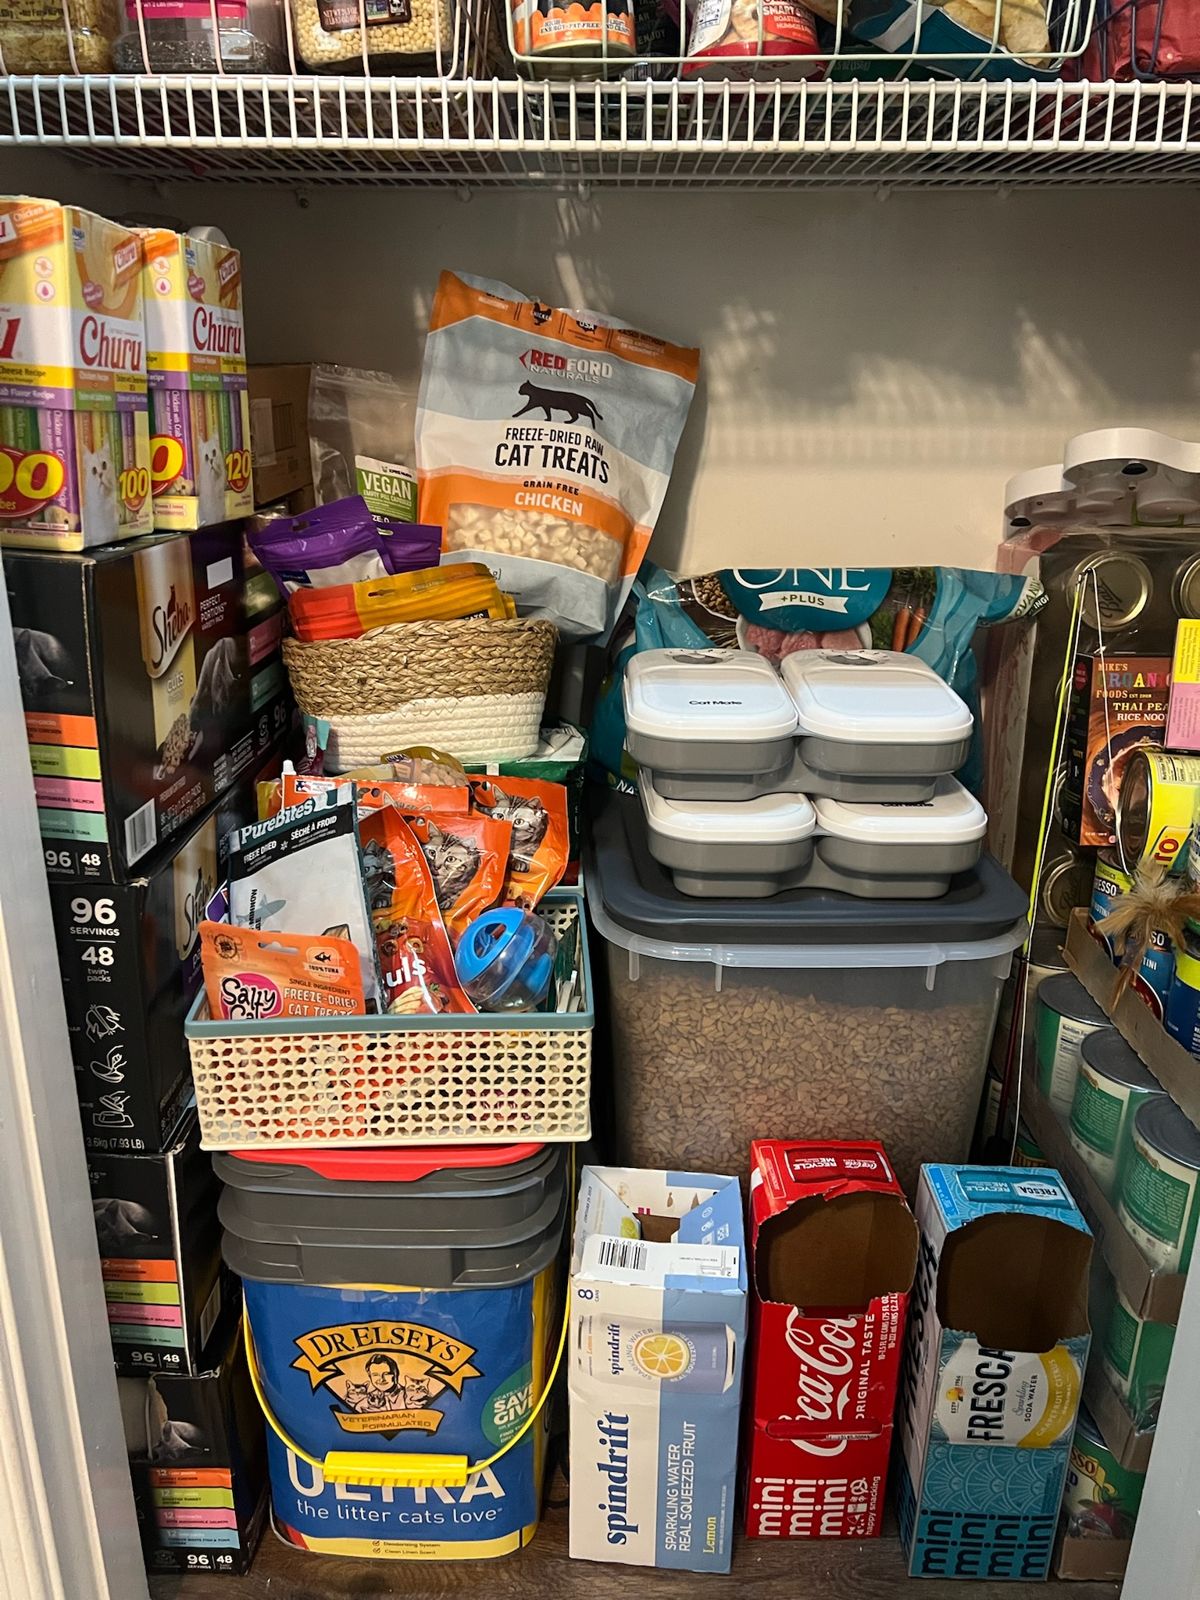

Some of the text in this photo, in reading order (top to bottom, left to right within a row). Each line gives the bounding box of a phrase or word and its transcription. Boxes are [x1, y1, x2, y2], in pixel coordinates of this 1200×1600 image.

[79, 315, 142, 372] Churu
[193, 306, 242, 354] Churu
[529, 365, 600, 384] NATURALS
[506, 427, 605, 456] FREEZE-DRIED RAW
[225, 449, 250, 481] 120
[495, 442, 610, 485] CAT TREATS
[119, 468, 148, 500] 100
[361, 471, 412, 501] VEGAN
[523, 480, 580, 496] GRAIN FREE
[514, 491, 584, 518] CHICKEN
[200, 593, 222, 612] PERFECT
[781, 594, 826, 607] +PLUS
[152, 602, 192, 670] Sheba
[1098, 663, 1128, 671] MIKE'S
[1095, 690, 1128, 699] FOODS
[1112, 702, 1168, 711] THAI PEA
[1117, 713, 1167, 721] RICE NOO
[240, 799, 314, 846] PureBites
[243, 848, 261, 864] FREEZE
[316, 815, 338, 830] FROID
[45, 850, 101, 867] 96 48
[70, 897, 117, 925] 96
[70, 926, 120, 937] SERVINGS
[81, 946, 115, 966] 48
[324, 966, 339, 974] TUNA
[87, 967, 110, 975] twin-
[87, 974, 112, 983] packs
[221, 977, 276, 1012] Salty
[284, 987, 358, 1009] FREEZE-DRIED
[289, 978, 351, 996] SINGLE INGREDIENT
[288, 1003, 309, 1017] CAT
[1020, 1186, 1057, 1196] FRESCA
[578, 1288, 593, 1300] 8
[608, 1323, 624, 1376] spindrift
[861, 1314, 875, 1359] TASTE
[131, 1351, 180, 1363] 96 48
[1048, 1359, 1063, 1387] CITRUS
[966, 1347, 1016, 1442] FRESCA
[1013, 1380, 1029, 1417] Sparkling
[1024, 1374, 1038, 1422] SODA WATER
[341, 1411, 416, 1423] VETERINARIAN
[361, 1420, 432, 1430] FORMULATED
[597, 1411, 639, 1546] spindrift
[679, 1420, 697, 1552] REAL SQUEEZED FRUIT
[664, 1443, 681, 1551] SPARKLING WATER
[753, 1477, 785, 1536] mini
[784, 1478, 817, 1536] mini
[815, 1478, 848, 1536] mini
[865, 1475, 881, 1536] happy snacking
[297, 1499, 497, 1525] the litter cats love
[702, 1516, 717, 1554] Lemon
[917, 1510, 953, 1574] mini
[951, 1511, 987, 1575] mini
[984, 1514, 1021, 1577] mini
[1017, 1514, 1054, 1578] mini
[187, 1554, 233, 1565] 96 48
